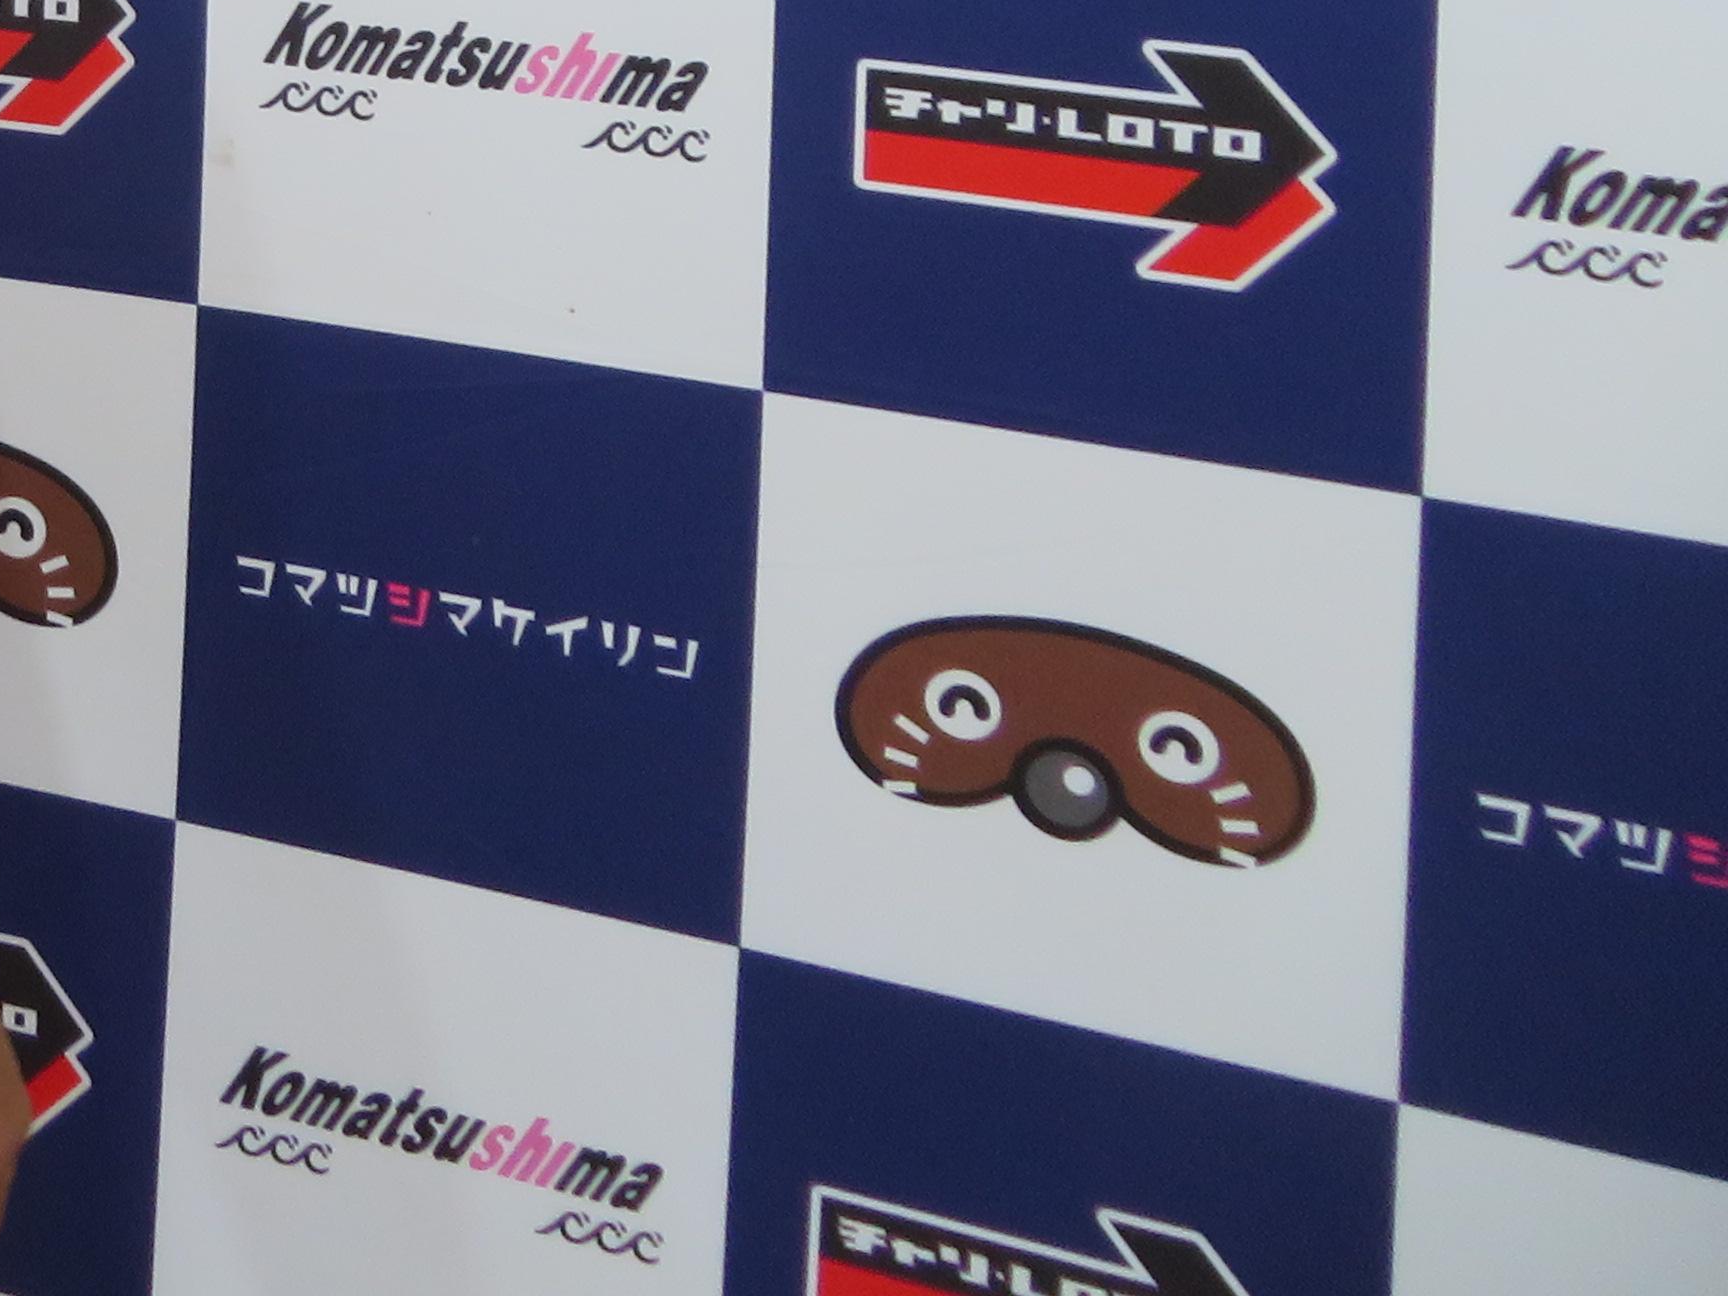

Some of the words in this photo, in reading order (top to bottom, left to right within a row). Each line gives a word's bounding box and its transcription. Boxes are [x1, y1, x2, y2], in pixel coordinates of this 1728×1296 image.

[263, 1, 708, 112] Komatsushima
[236, 557, 698, 678] コマツシマケイリン
[219, 1045, 663, 1213] Komatsushima
